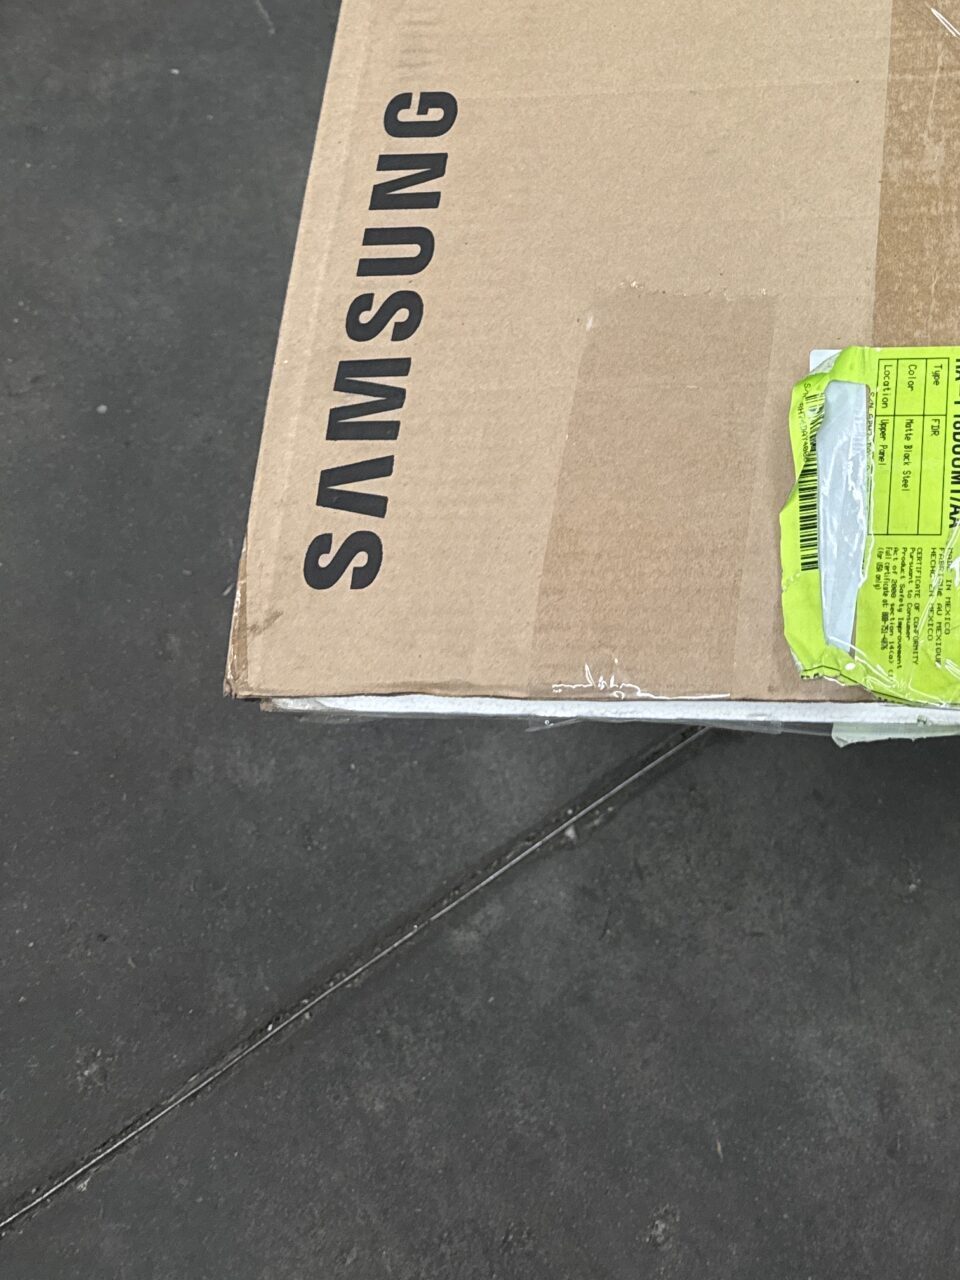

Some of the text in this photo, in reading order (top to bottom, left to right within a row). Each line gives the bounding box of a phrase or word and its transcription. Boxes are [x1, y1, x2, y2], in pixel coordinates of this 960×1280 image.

[304, 90, 458, 590] SAMSUNG
[930, 364, 942, 436] Type FDR
[878, 364, 892, 465] Location Upper Panel
[901, 364, 916, 491] Color Matte Black Steel
[892, 565, 897, 574] of
[914, 547, 922, 598] CERTIFICATE
[897, 583, 905, 611] Safety
[906, 589, 912, 598] to
[945, 579, 952, 590] IN
[913, 602, 920, 611] OF
[936, 603, 942, 615] AU
